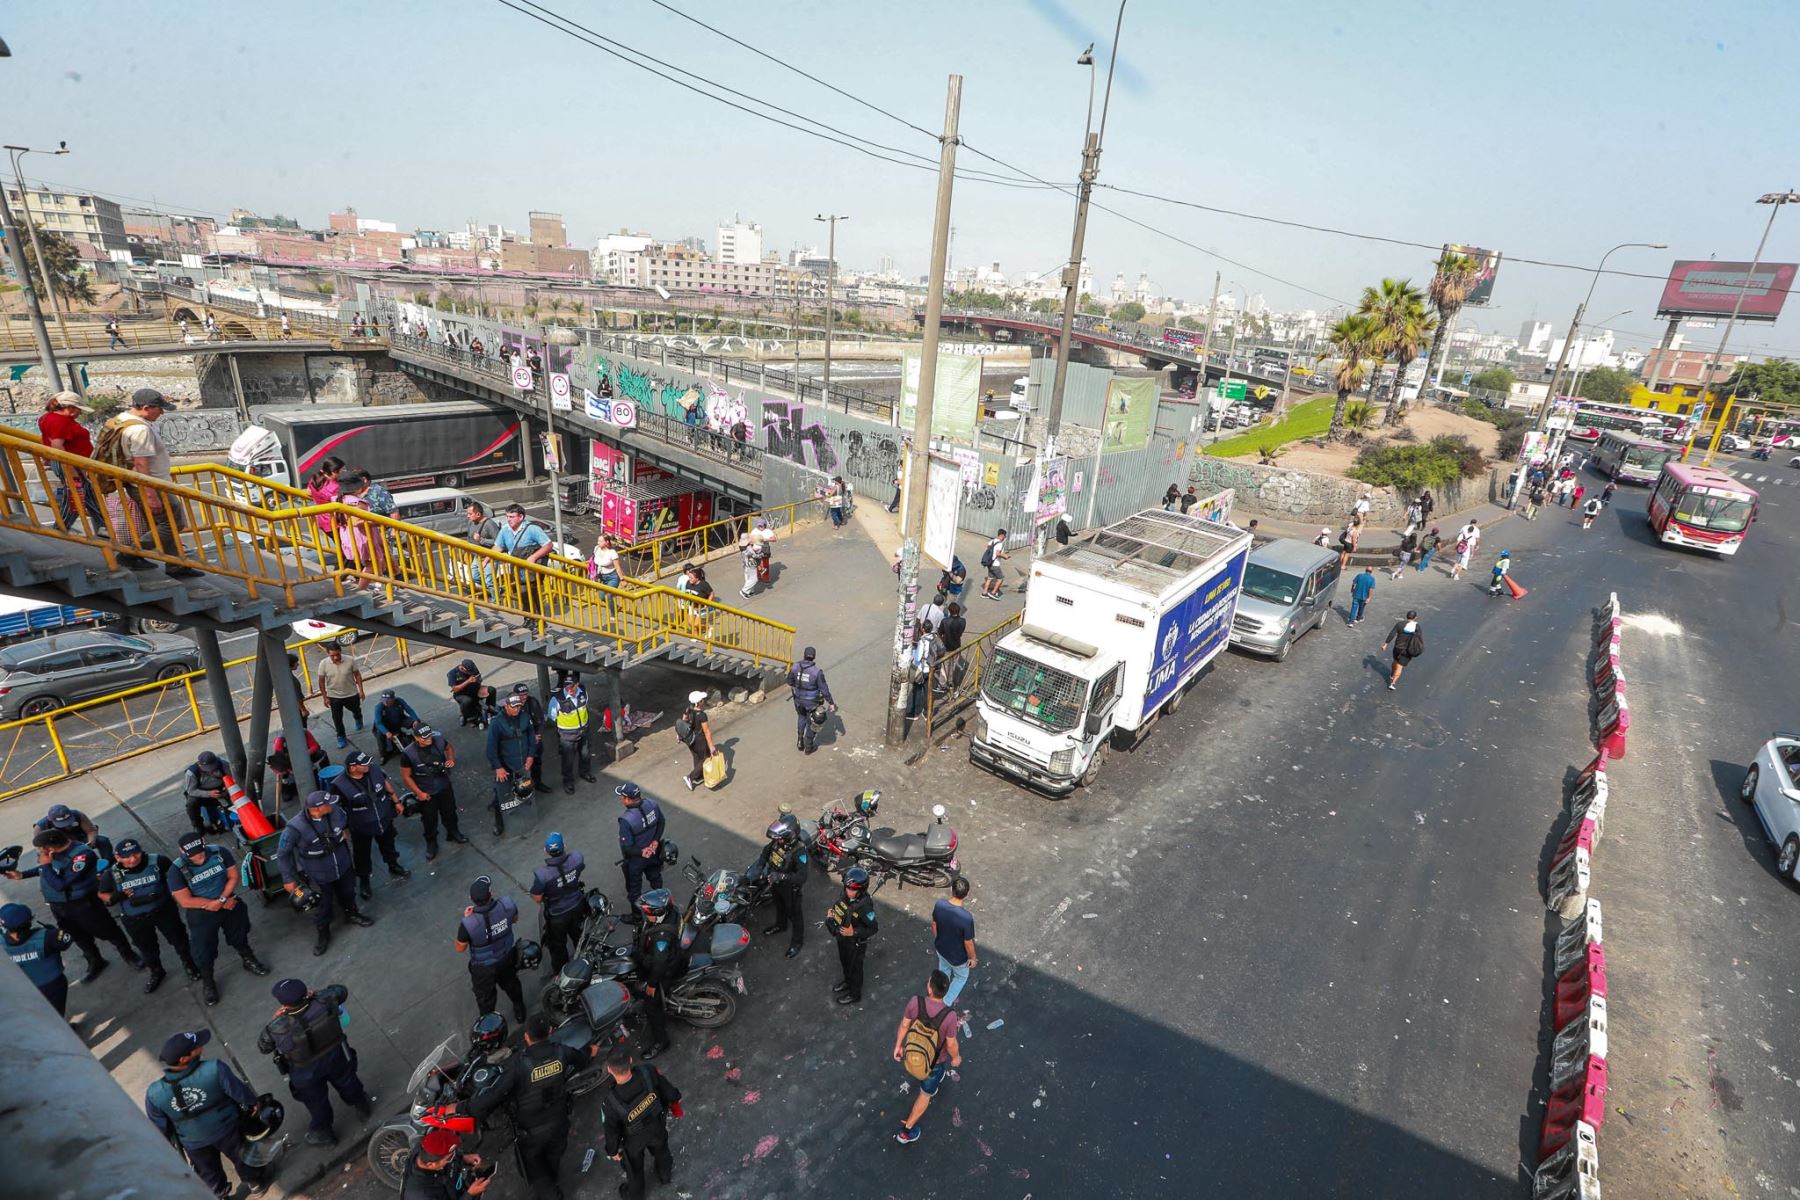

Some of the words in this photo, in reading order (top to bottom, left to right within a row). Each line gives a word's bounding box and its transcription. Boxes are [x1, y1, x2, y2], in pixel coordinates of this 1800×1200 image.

[516, 372, 528, 381] 80
[616, 407, 630, 417] 80
[593, 456, 609, 471] BIG
[1147, 660, 1176, 694] LIMA
[1007, 731, 1031, 745] ISUZU
[533, 1061, 560, 1080] HALCONES
[630, 1094, 655, 1120] HALCONES
